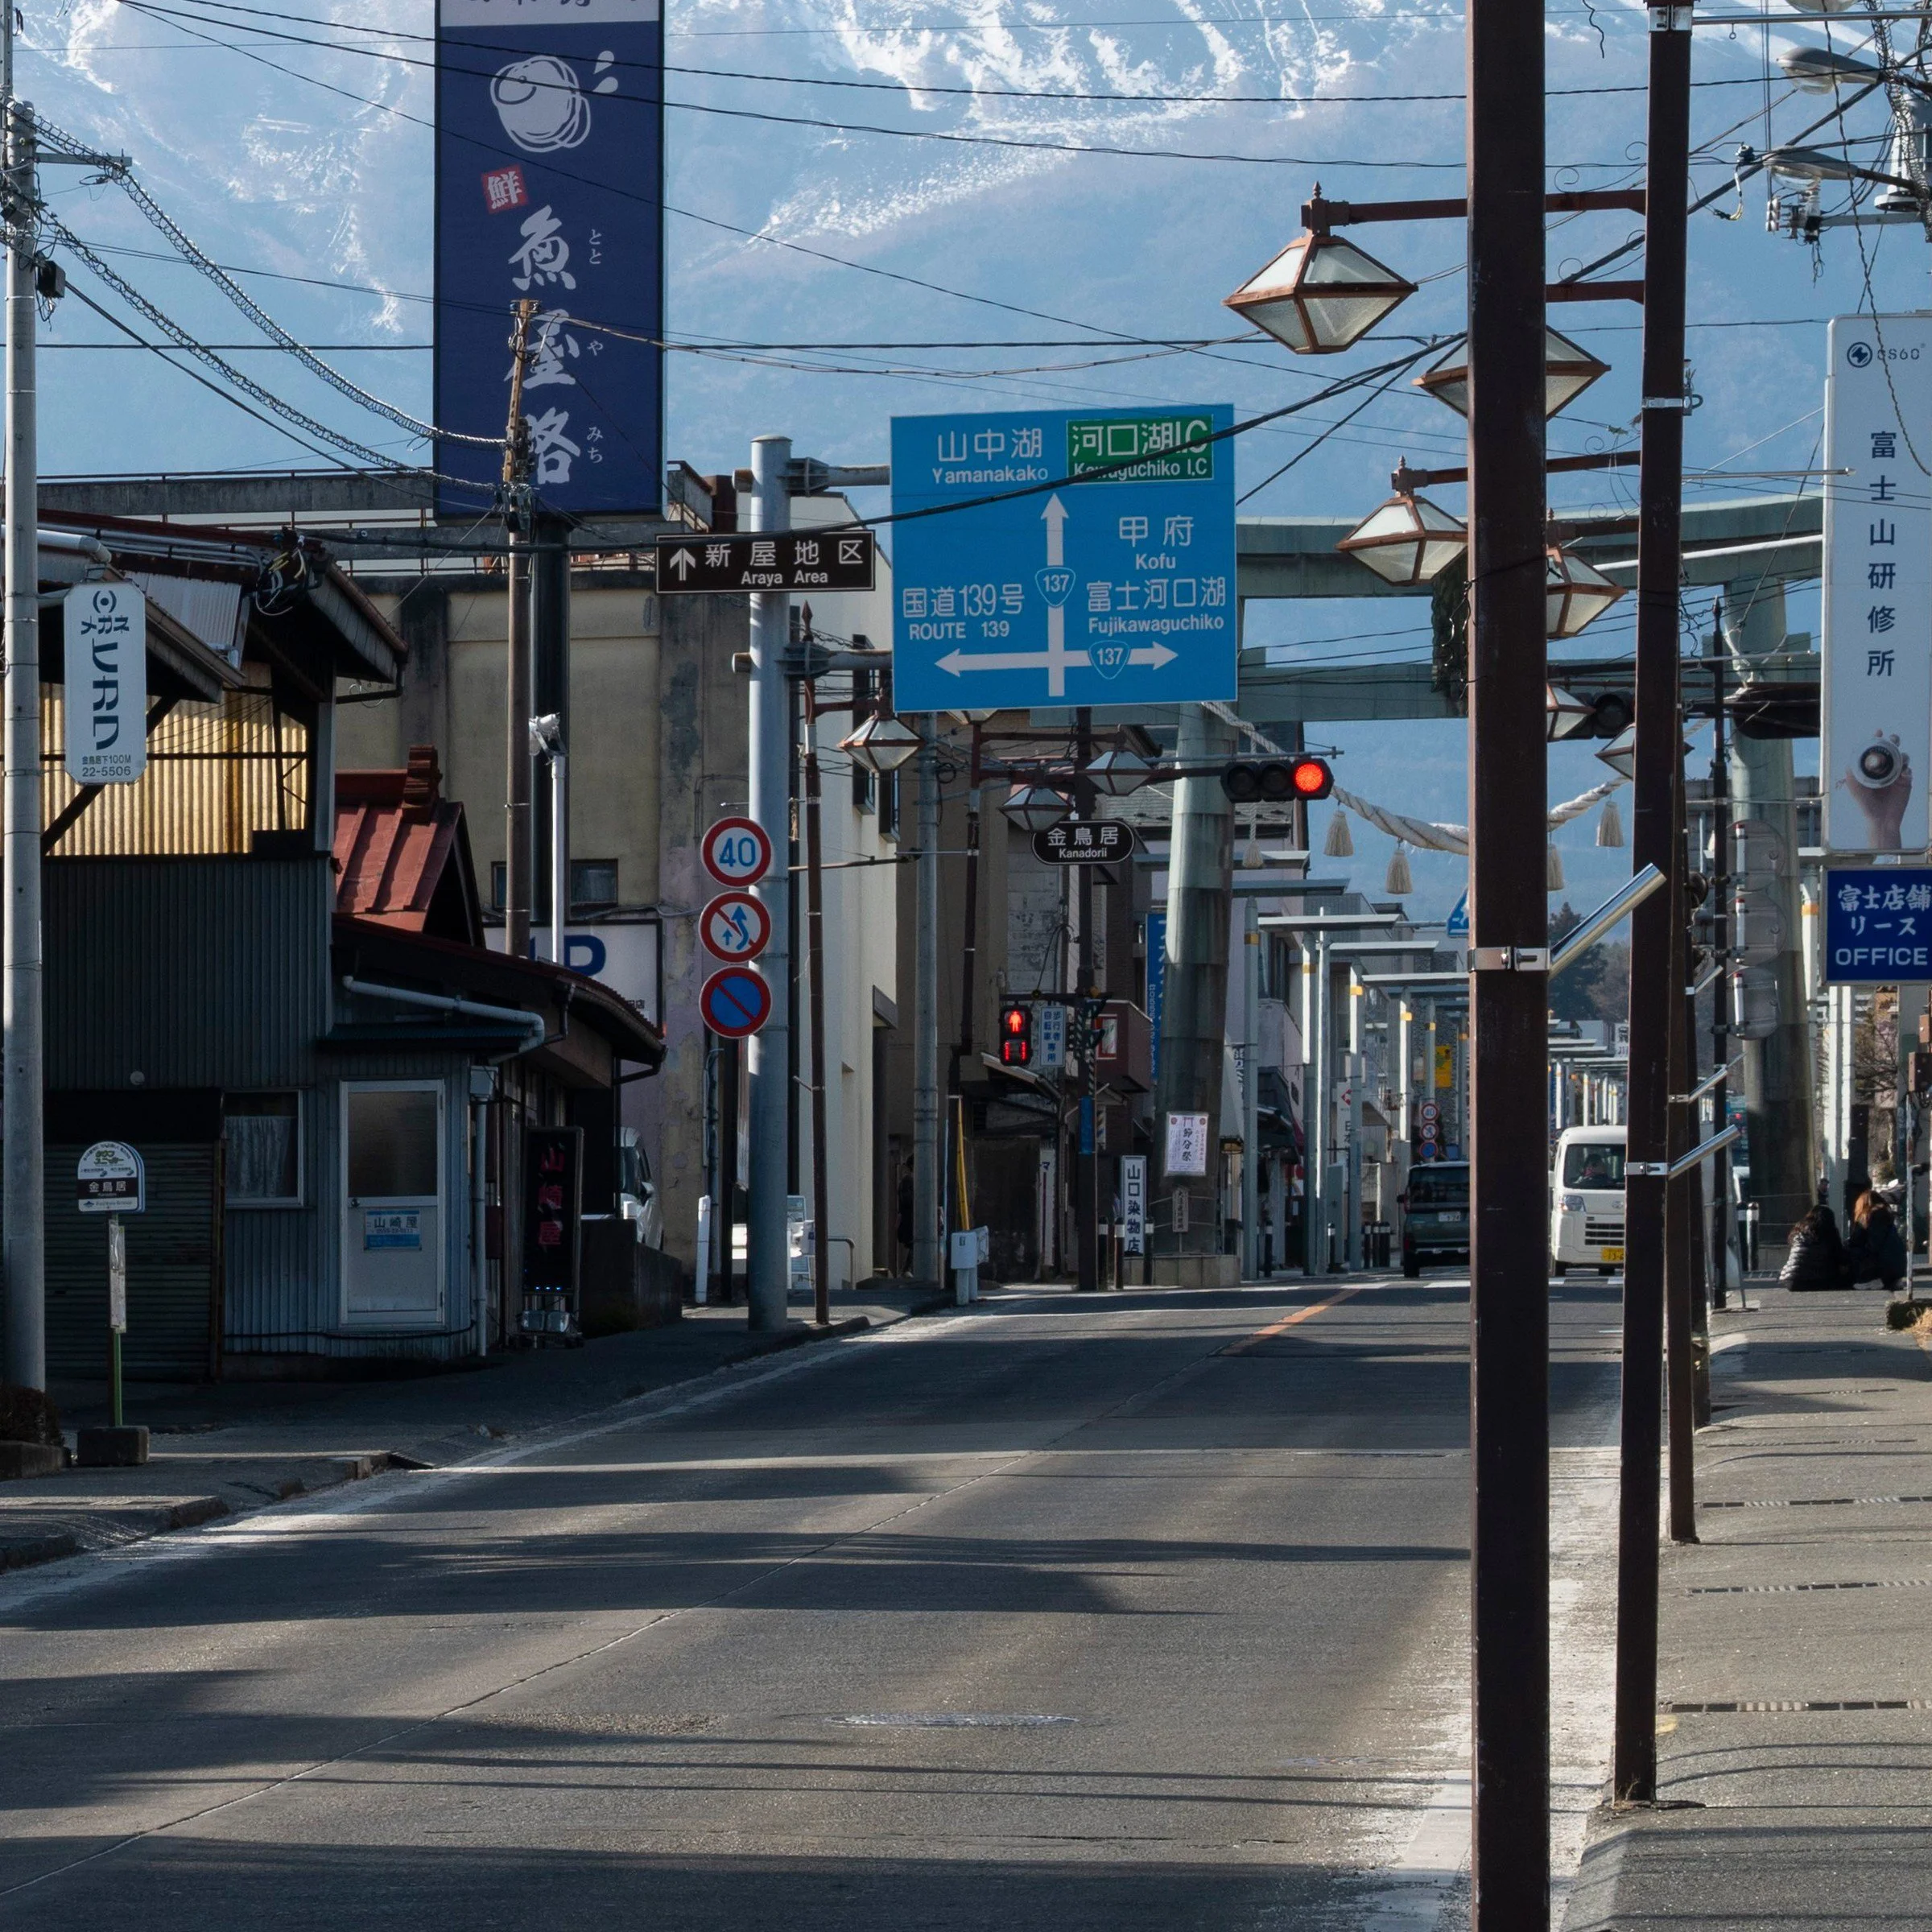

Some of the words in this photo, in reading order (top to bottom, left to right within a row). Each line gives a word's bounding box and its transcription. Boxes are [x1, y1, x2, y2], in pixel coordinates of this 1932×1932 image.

[488, 171, 522, 209] 鮮
[589, 229, 602, 264] とと
[587, 341, 603, 356] や
[587, 427, 604, 464] みち
[938, 427, 1042, 462] 山中湖
[932, 464, 1049, 485] Yamanakako
[1074, 459, 1180, 481] Kaaguchiko
[1187, 457, 1208, 476] I.C
[1119, 515, 1195, 547] 甲府
[705, 539, 864, 568] 新屋地区
[1136, 553, 1176, 570] Kofu
[1867, 431, 1897, 677] 富士山研修所
[741, 571, 783, 587] Araya
[794, 570, 828, 584] Area
[1042, 574, 1070, 592] 137
[902, 584, 1026, 618] 国道139号
[1086, 576, 1226, 612] 富士河口湖
[81, 616, 130, 634] メガネ
[909, 621, 966, 640] ROUTE
[981, 621, 1009, 638] 139
[1088, 613, 1224, 637] Fujikawaguchiko
[1096, 647, 1124, 666] 137
[82, 766, 131, 777] 22-5506
[1047, 827, 1119, 846] 金鳥居
[719, 837, 756, 867] 40
[1059, 848, 1108, 859] Kanadorii
[1838, 884, 1932, 911] 富士店舗
[1852, 915, 1917, 936] リース
[1835, 947, 1929, 966] OFFICE
[1044, 1011, 1052, 1040] 自転車
[1053, 1011, 1061, 1041] 歩行者
[89, 1180, 126, 1193] 金鳥居
[1127, 1164, 1141, 1252] 山口染物店
